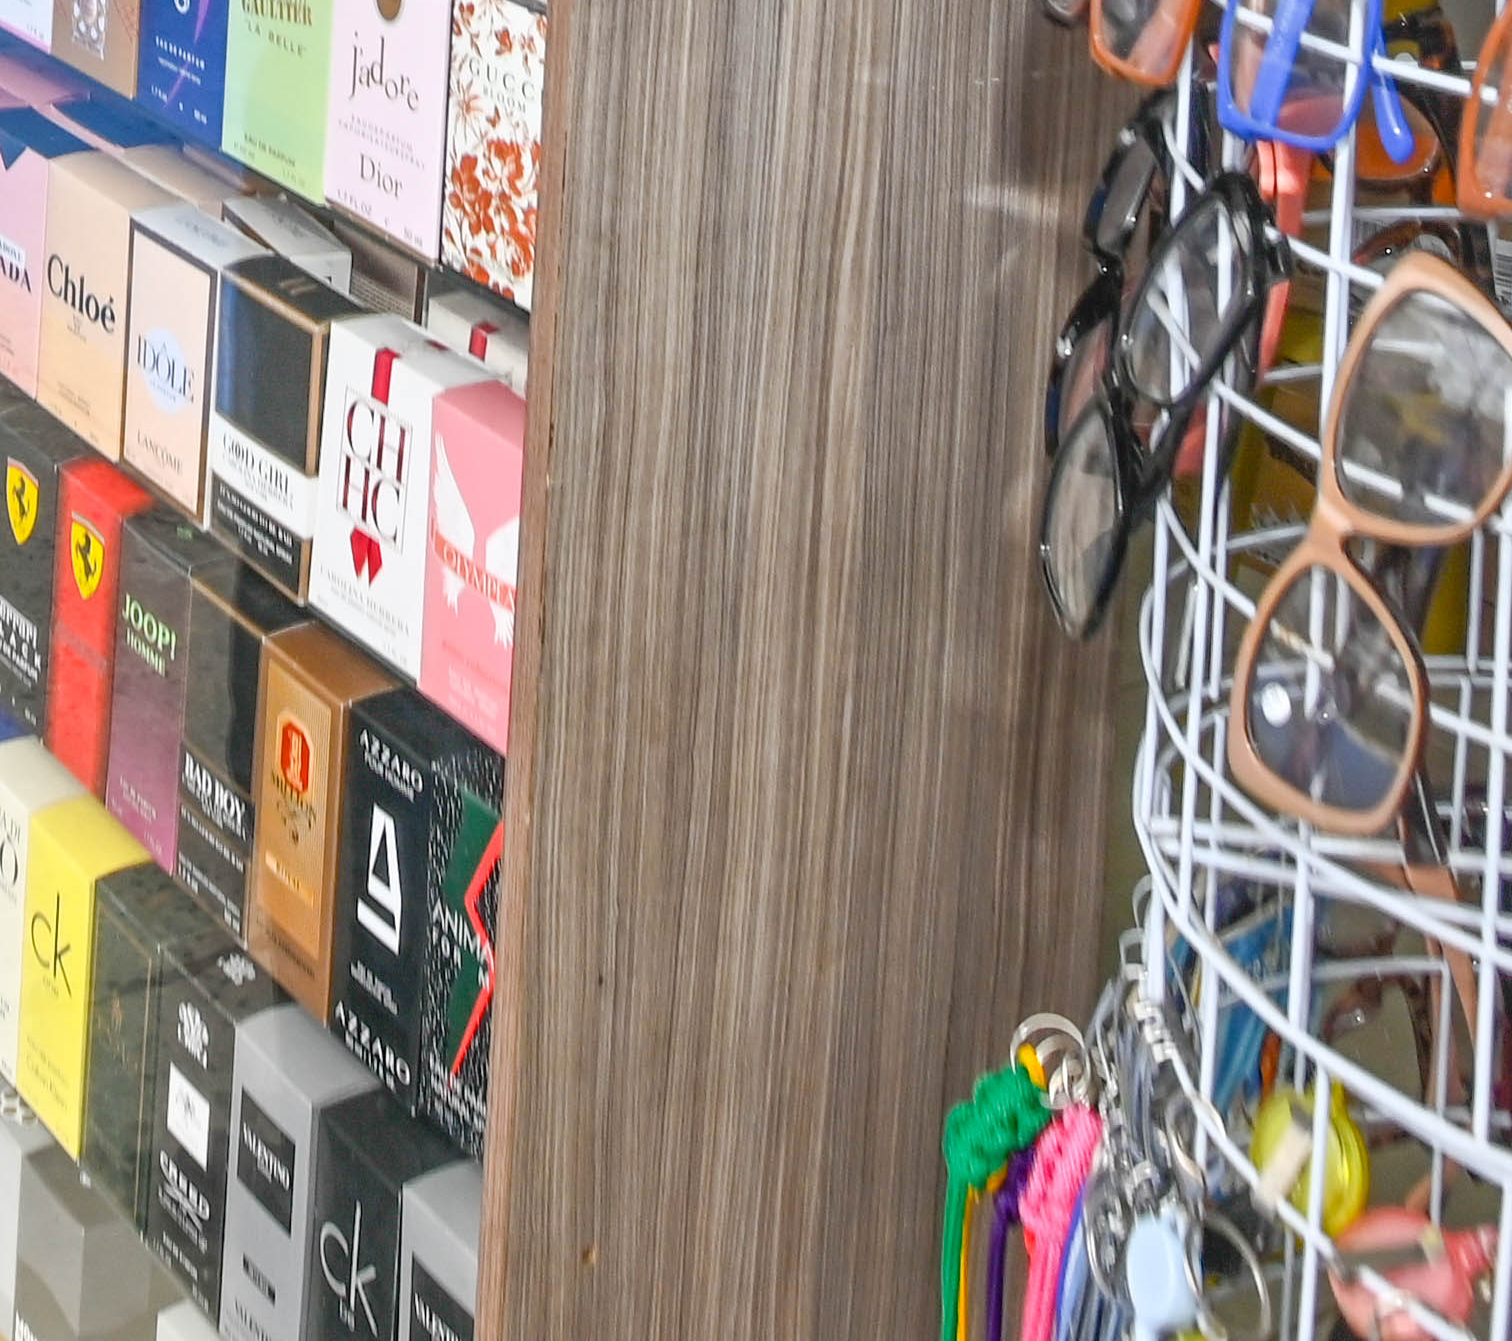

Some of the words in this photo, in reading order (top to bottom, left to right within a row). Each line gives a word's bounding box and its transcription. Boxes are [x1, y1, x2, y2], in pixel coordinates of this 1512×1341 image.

[468, 57, 535, 102] GUCC
[359, 152, 403, 200] Dior
[47, 253, 116, 334] Chloé
[137, 333, 196, 405] IDÔLE
[347, 399, 407, 484] CH
[342, 453, 401, 545] HC
[123, 592, 177, 661] JOOP!
[126, 633, 166, 678] HOMME
[184, 751, 212, 795] BAD
[213, 778, 247, 824] BOY
[360, 727, 424, 794] AZZARO
[31, 892, 72, 998] ck
[335, 1000, 411, 1086] AZZARO
[242, 1121, 290, 1192] VALENTINO
[319, 1200, 378, 1338] ck
